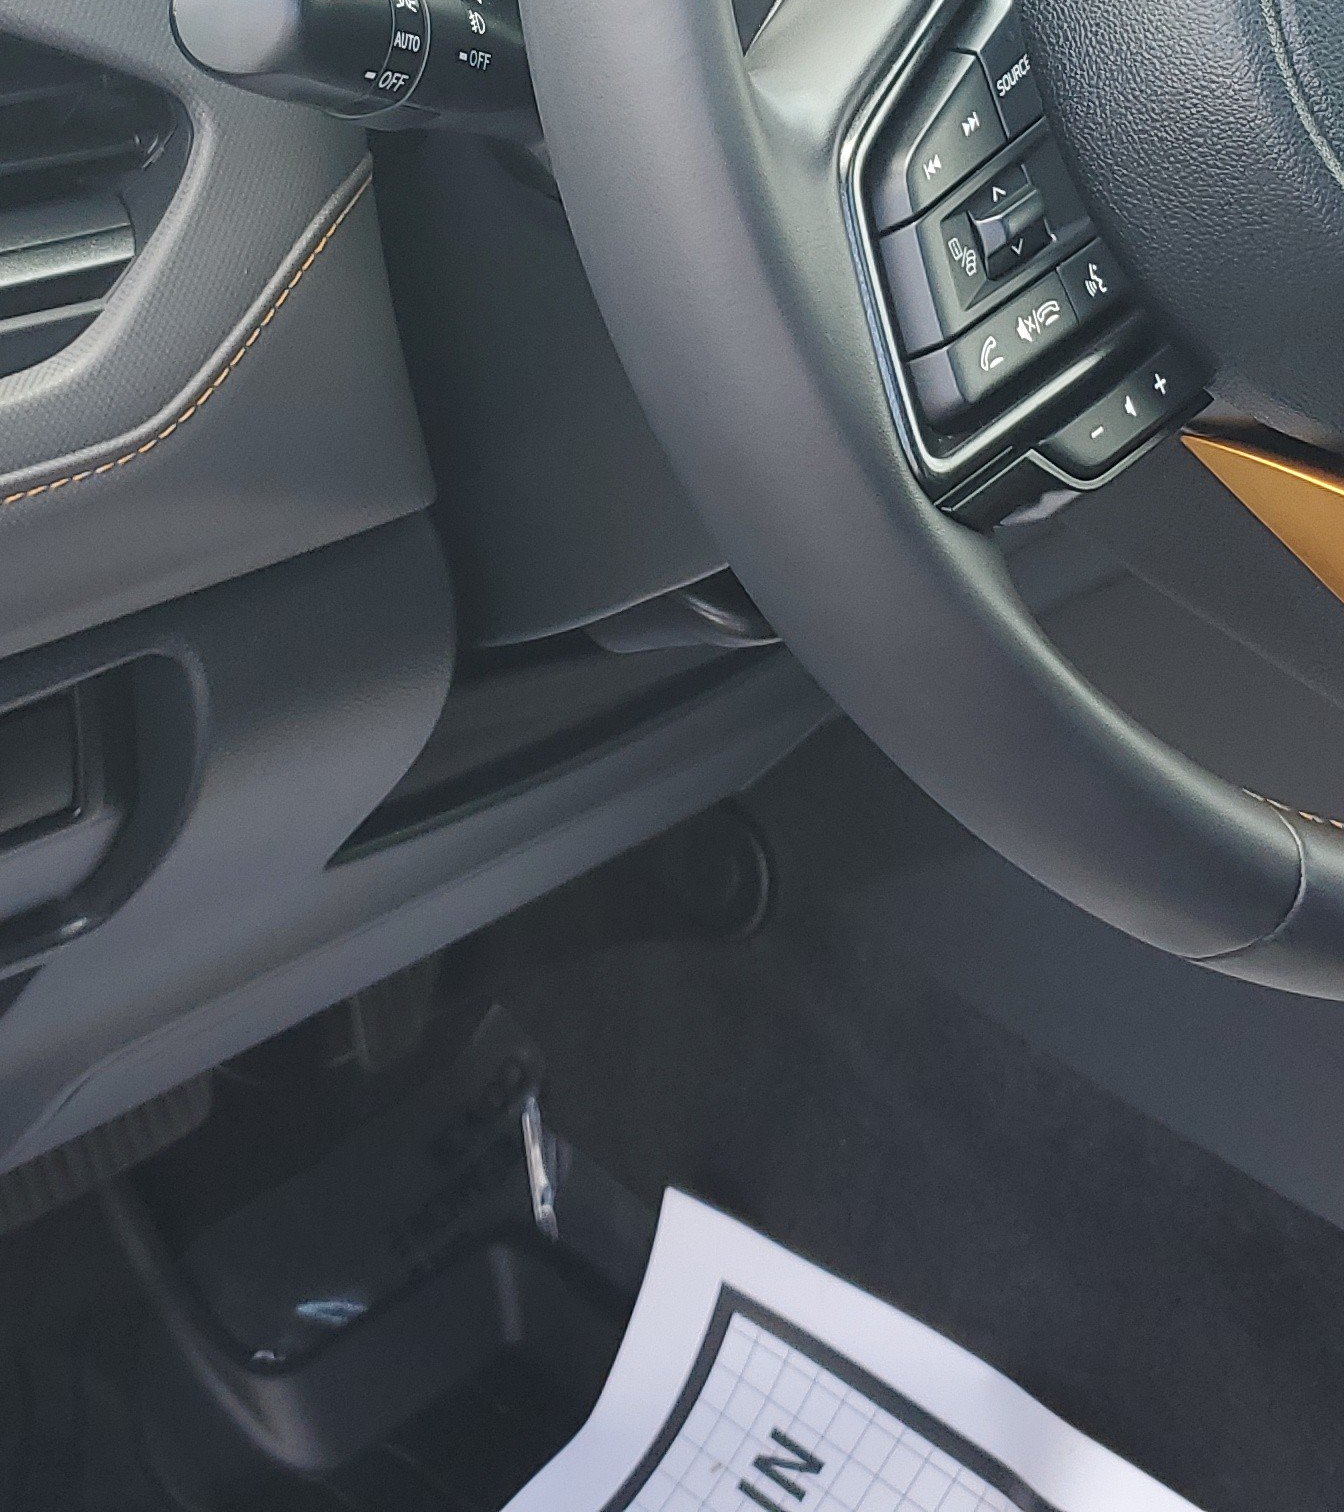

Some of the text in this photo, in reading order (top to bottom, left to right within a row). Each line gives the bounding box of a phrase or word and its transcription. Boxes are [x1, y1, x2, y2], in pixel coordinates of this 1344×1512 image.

[394, 31, 421, 52] AUTO
[469, 50, 492, 71] OFF
[379, 71, 409, 92] OFF
[996, 54, 1031, 97] SOURCE
